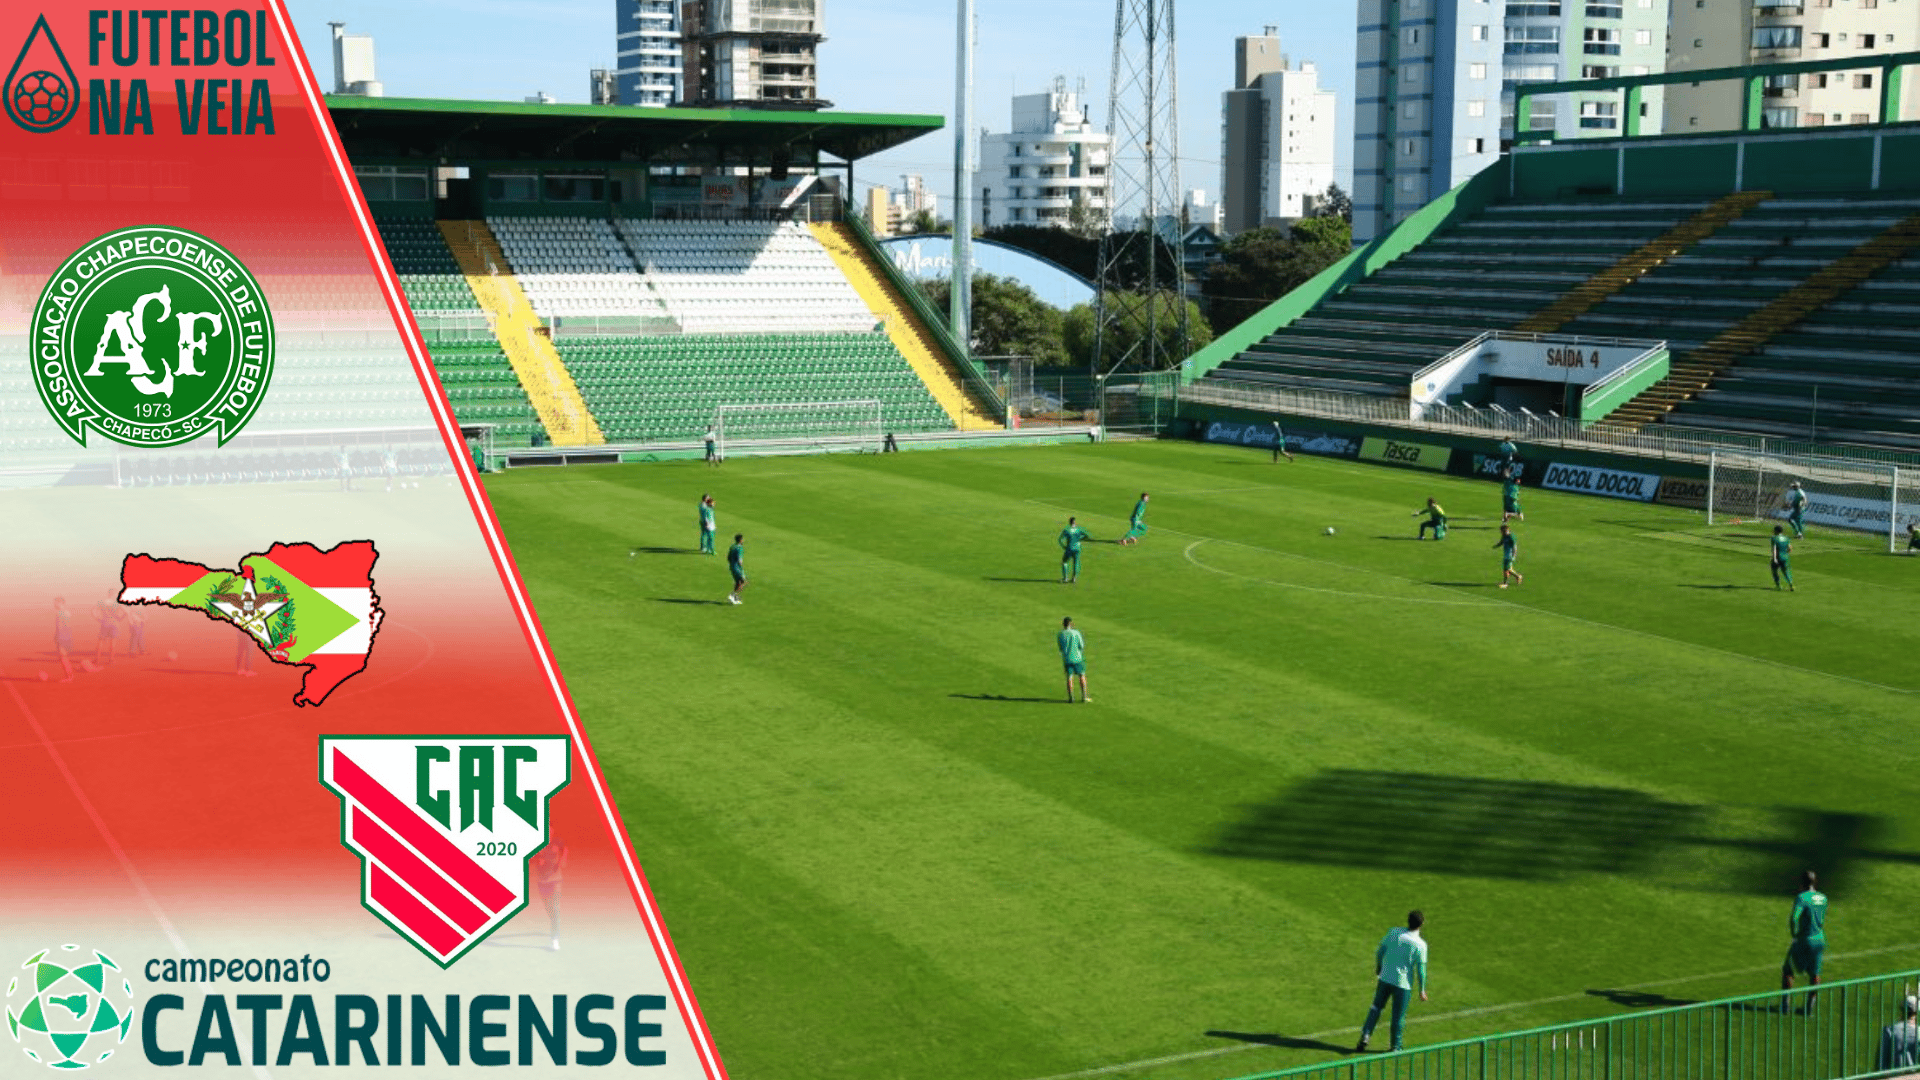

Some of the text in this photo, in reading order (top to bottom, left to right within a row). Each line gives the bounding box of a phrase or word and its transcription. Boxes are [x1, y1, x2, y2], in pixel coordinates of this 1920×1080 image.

[1546, 345, 1600, 368] SAÍDA 4
[1383, 440, 1421, 462] Tasca
[1546, 466, 1644, 496] DOCOL DOCOL
